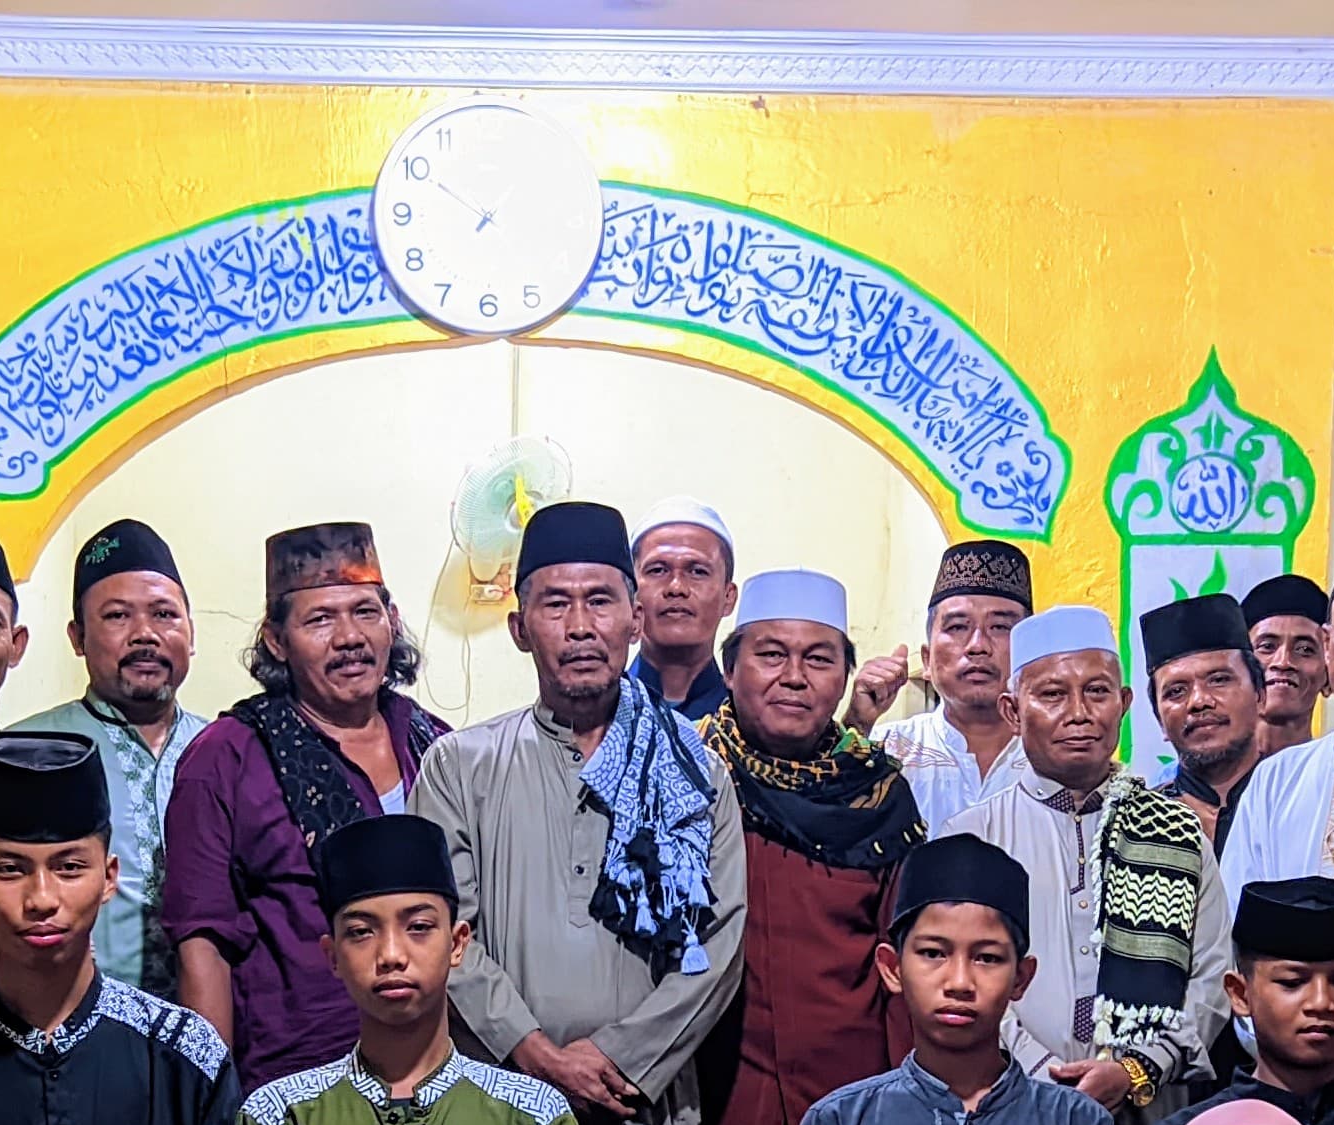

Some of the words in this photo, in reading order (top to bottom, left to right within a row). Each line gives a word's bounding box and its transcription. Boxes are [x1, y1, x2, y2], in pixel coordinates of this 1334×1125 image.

[436, 127, 452, 151] 11
[402, 155, 430, 181] 10
[392, 202, 411, 226] 9
[405, 248, 424, 272] 8
[434, 283, 452, 307] 7
[479, 294, 498, 317] 6
[523, 285, 541, 308] 5
[1177, 459, 1248, 530] الله
